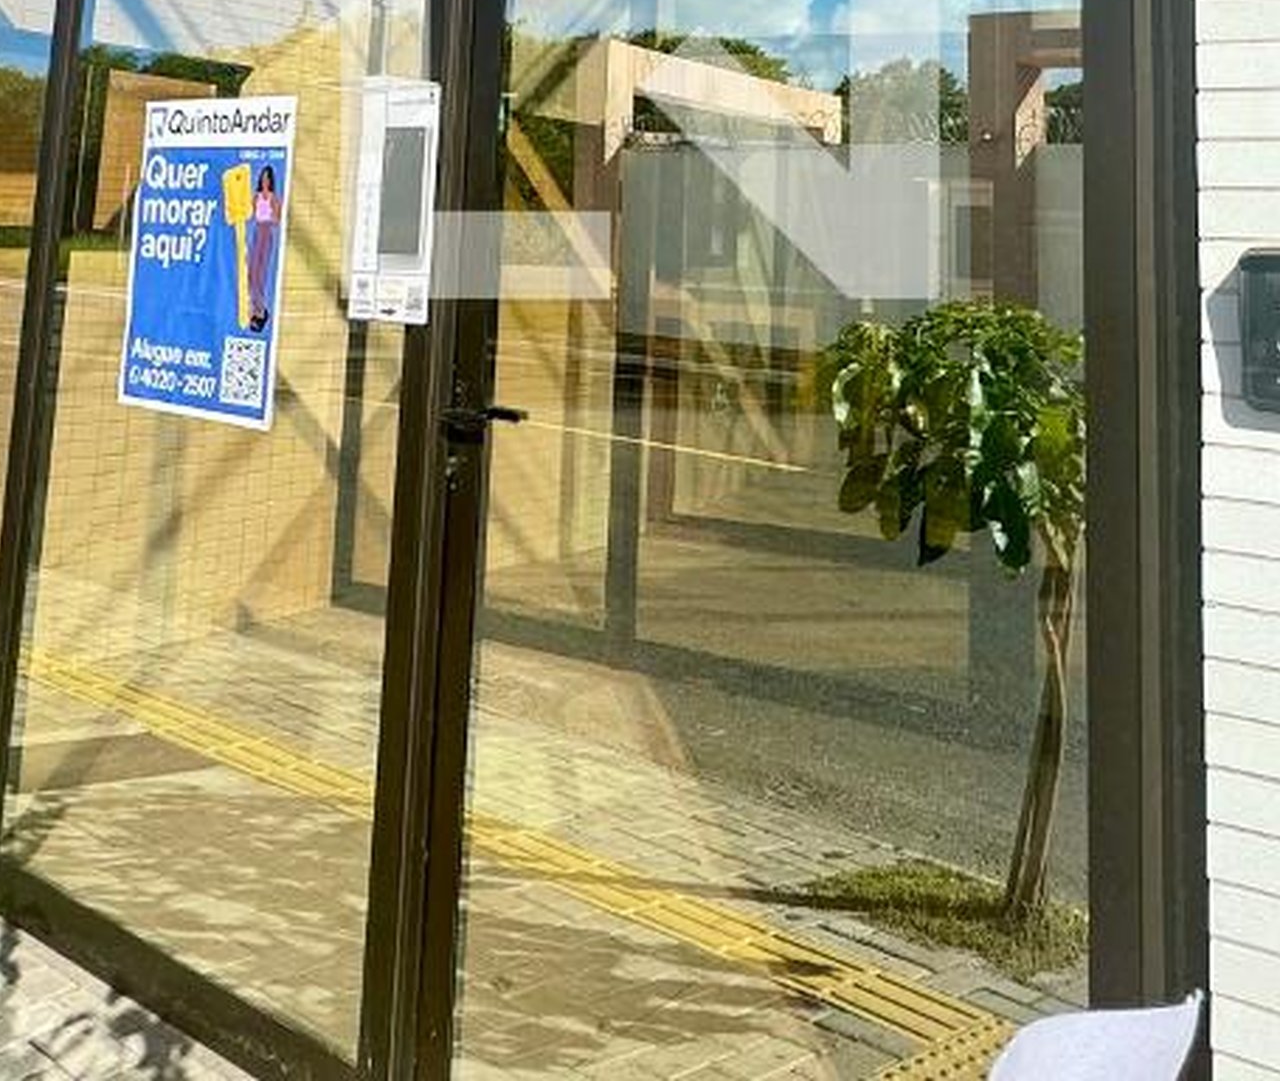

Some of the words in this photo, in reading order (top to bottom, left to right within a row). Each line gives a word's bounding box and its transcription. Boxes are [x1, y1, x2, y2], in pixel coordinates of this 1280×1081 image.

[169, 106, 292, 135] QuintoAndar
[145, 155, 209, 190] Quer
[141, 196, 217, 227] morar
[140, 229, 206, 268] aqui?
[130, 337, 183, 367] Alugue
